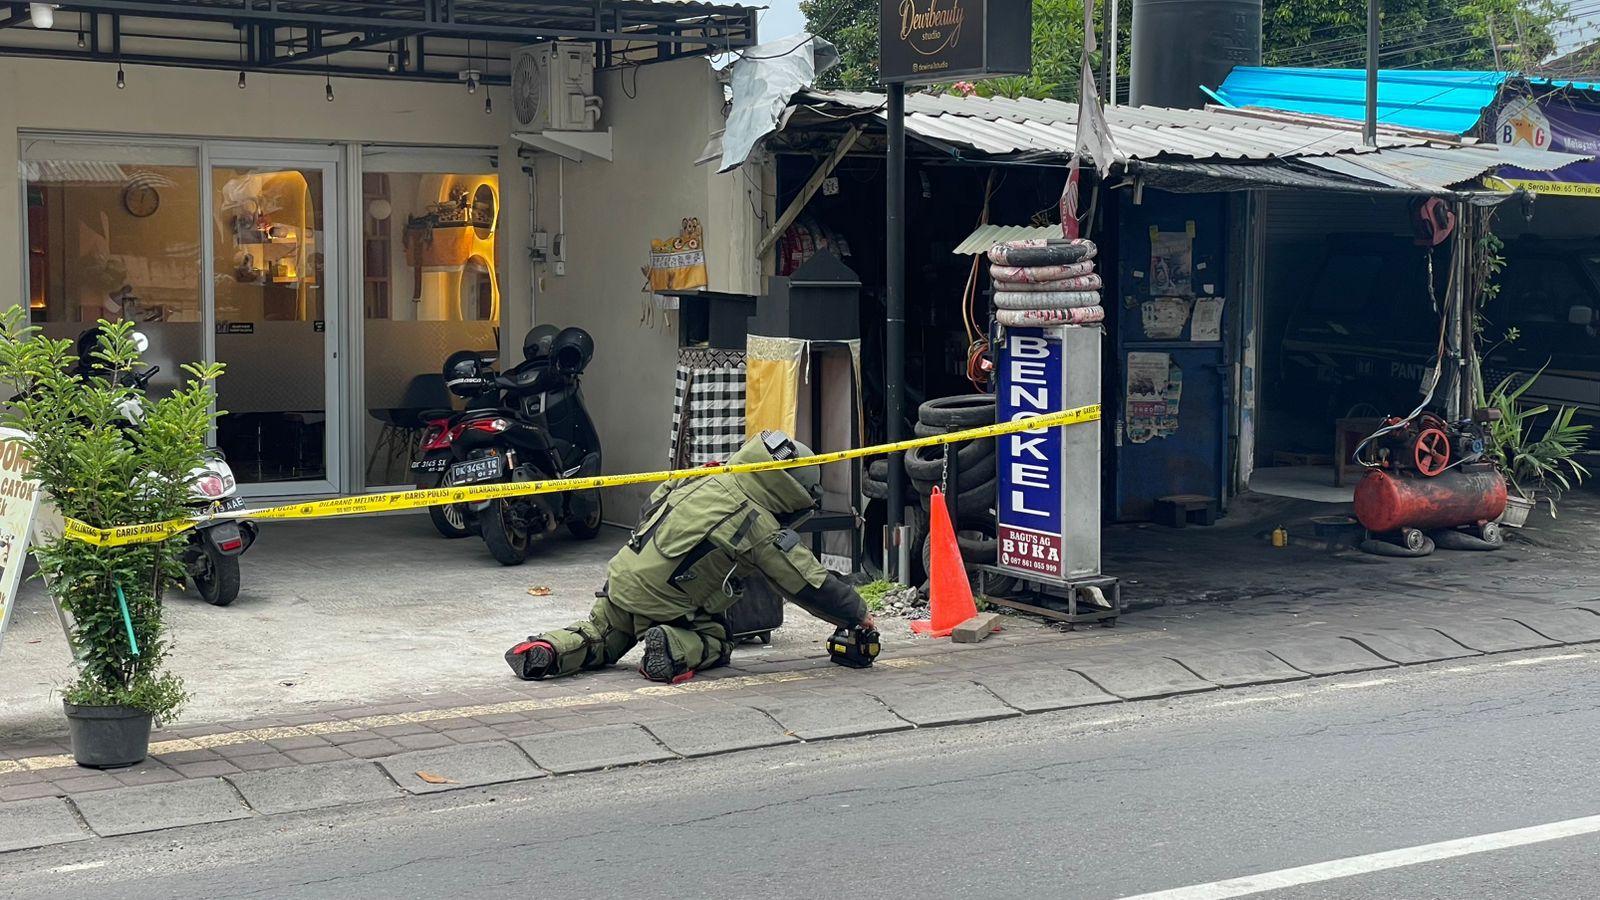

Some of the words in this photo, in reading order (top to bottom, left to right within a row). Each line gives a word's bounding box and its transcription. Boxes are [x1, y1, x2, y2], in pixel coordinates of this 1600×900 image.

[922, 30, 941, 40] studio
[1503, 125, 1512, 143] B
[1535, 128, 1545, 146] G
[1528, 183, 1550, 191] Seroja
[456, 465, 467, 476] DK
[467, 462, 486, 473] 3463
[487, 460, 497, 469] TR
[404, 492, 426, 501] GARIS
[427, 490, 449, 498] POLISI
[468, 485, 500, 494] DILARANG
[226, 497, 244, 510] AAE
[318, 497, 353, 508] DILARANG
[354, 495, 387, 505] MELINTAS
[70, 521, 98, 537] MELINTAS
[115, 526, 139, 538] GARIS
[140, 523, 164, 534] POLISI
[1010, 531, 1038, 544] BAGU'S
[1040, 536, 1050, 546] AG
[1003, 539, 1059, 562] BUKA
